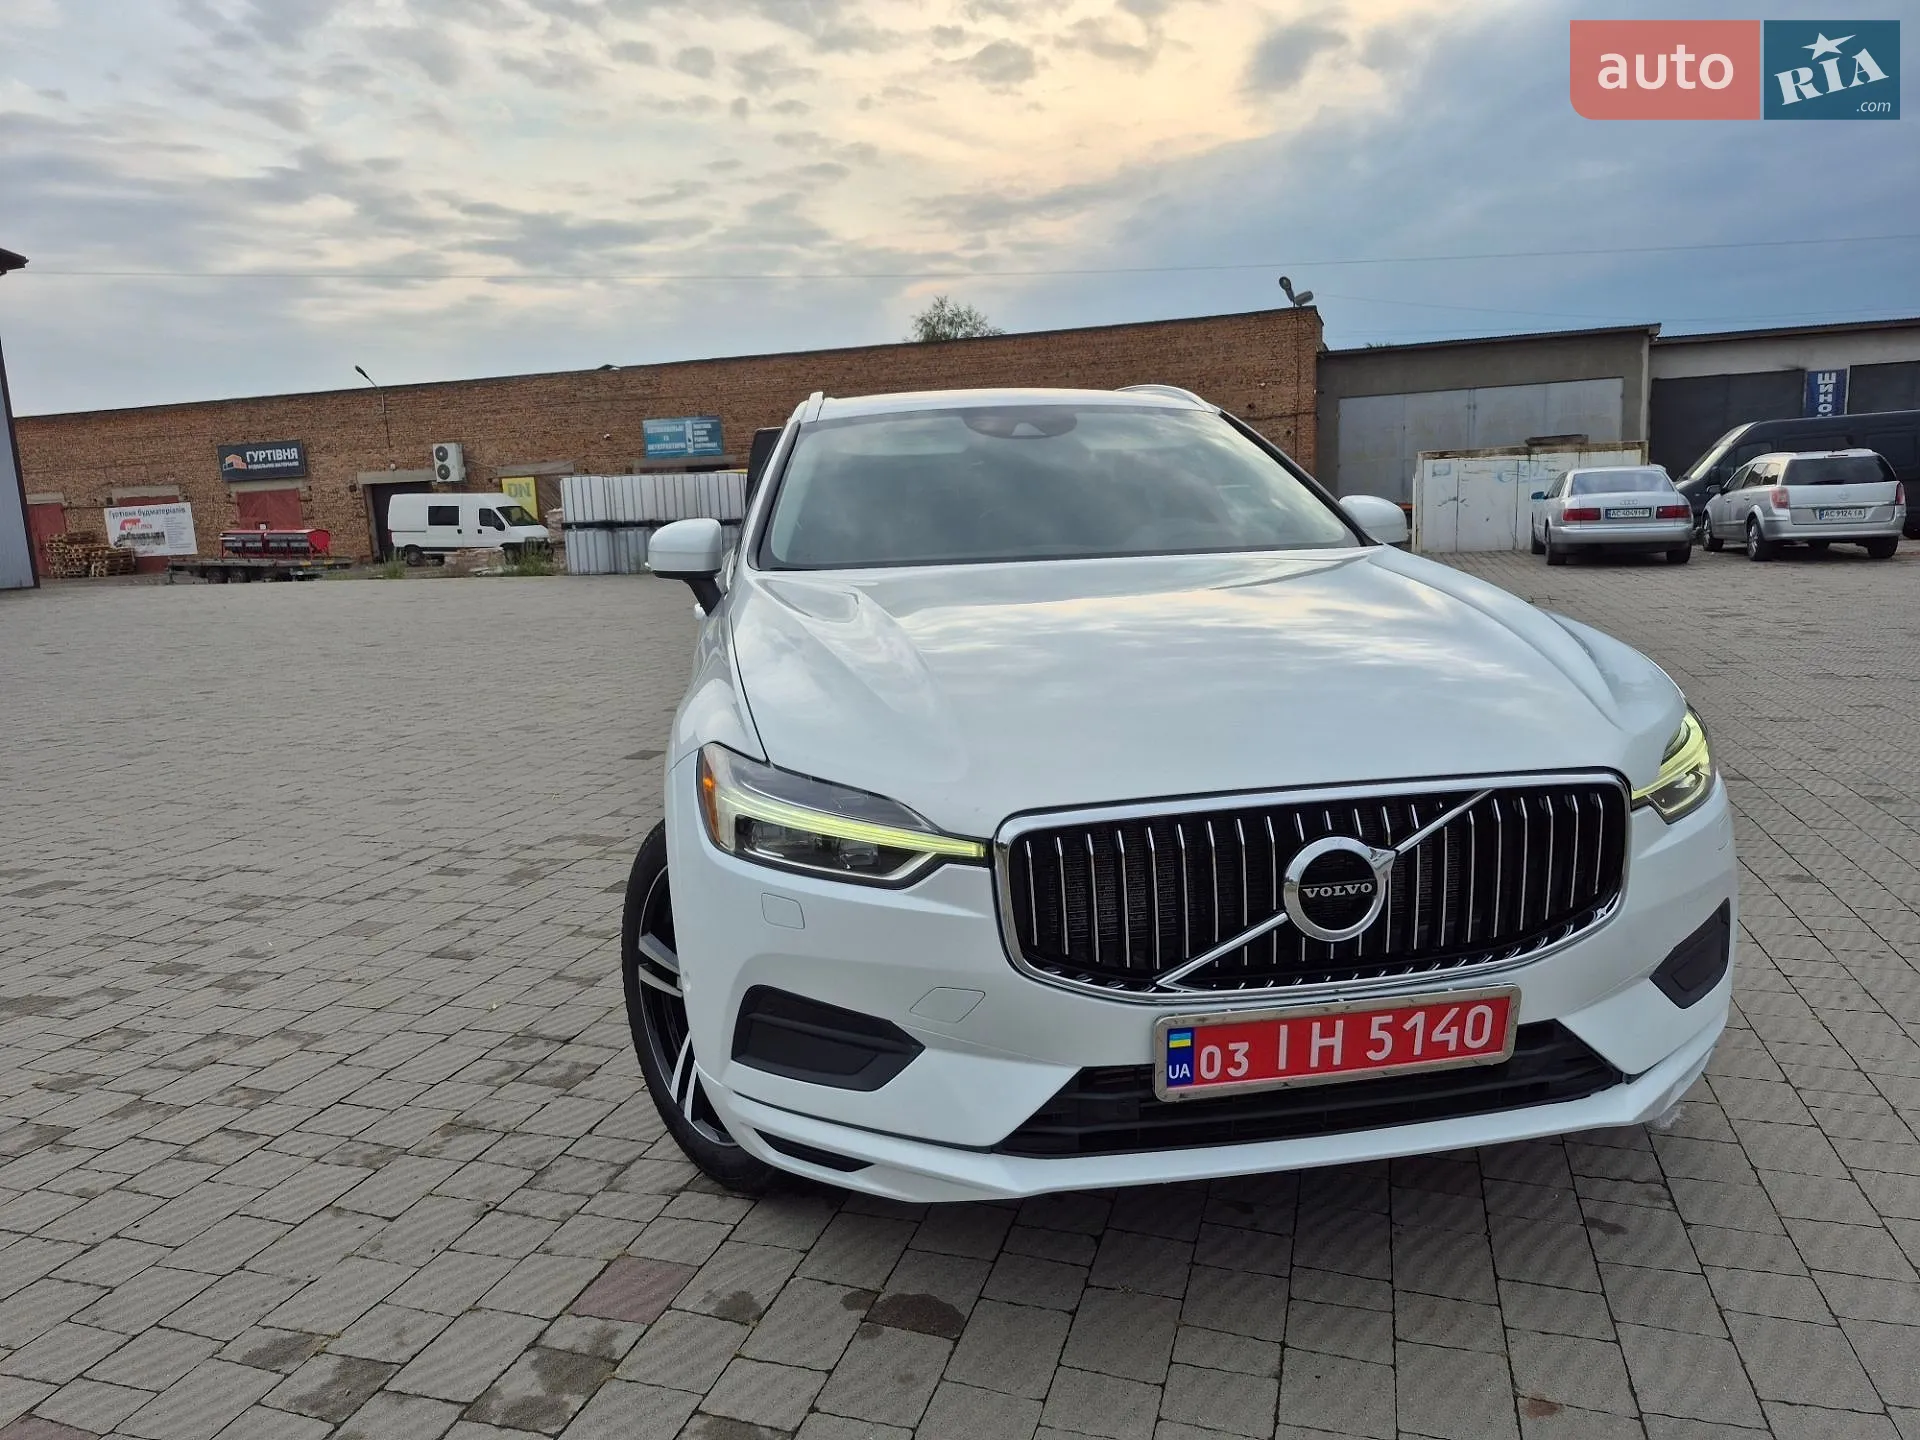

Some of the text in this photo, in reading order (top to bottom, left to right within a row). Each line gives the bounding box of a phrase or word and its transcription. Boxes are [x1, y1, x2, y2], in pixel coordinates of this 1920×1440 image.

[1817, 372, 1837, 418] ШИНО
[245, 447, 299, 463] ГУРТІВНЯ
[1303, 883, 1372, 898] VOLVO
[1200, 1042, 1249, 1080] 03
[1366, 1005, 1493, 1061] 5140
[1168, 1064, 1190, 1079] UA
